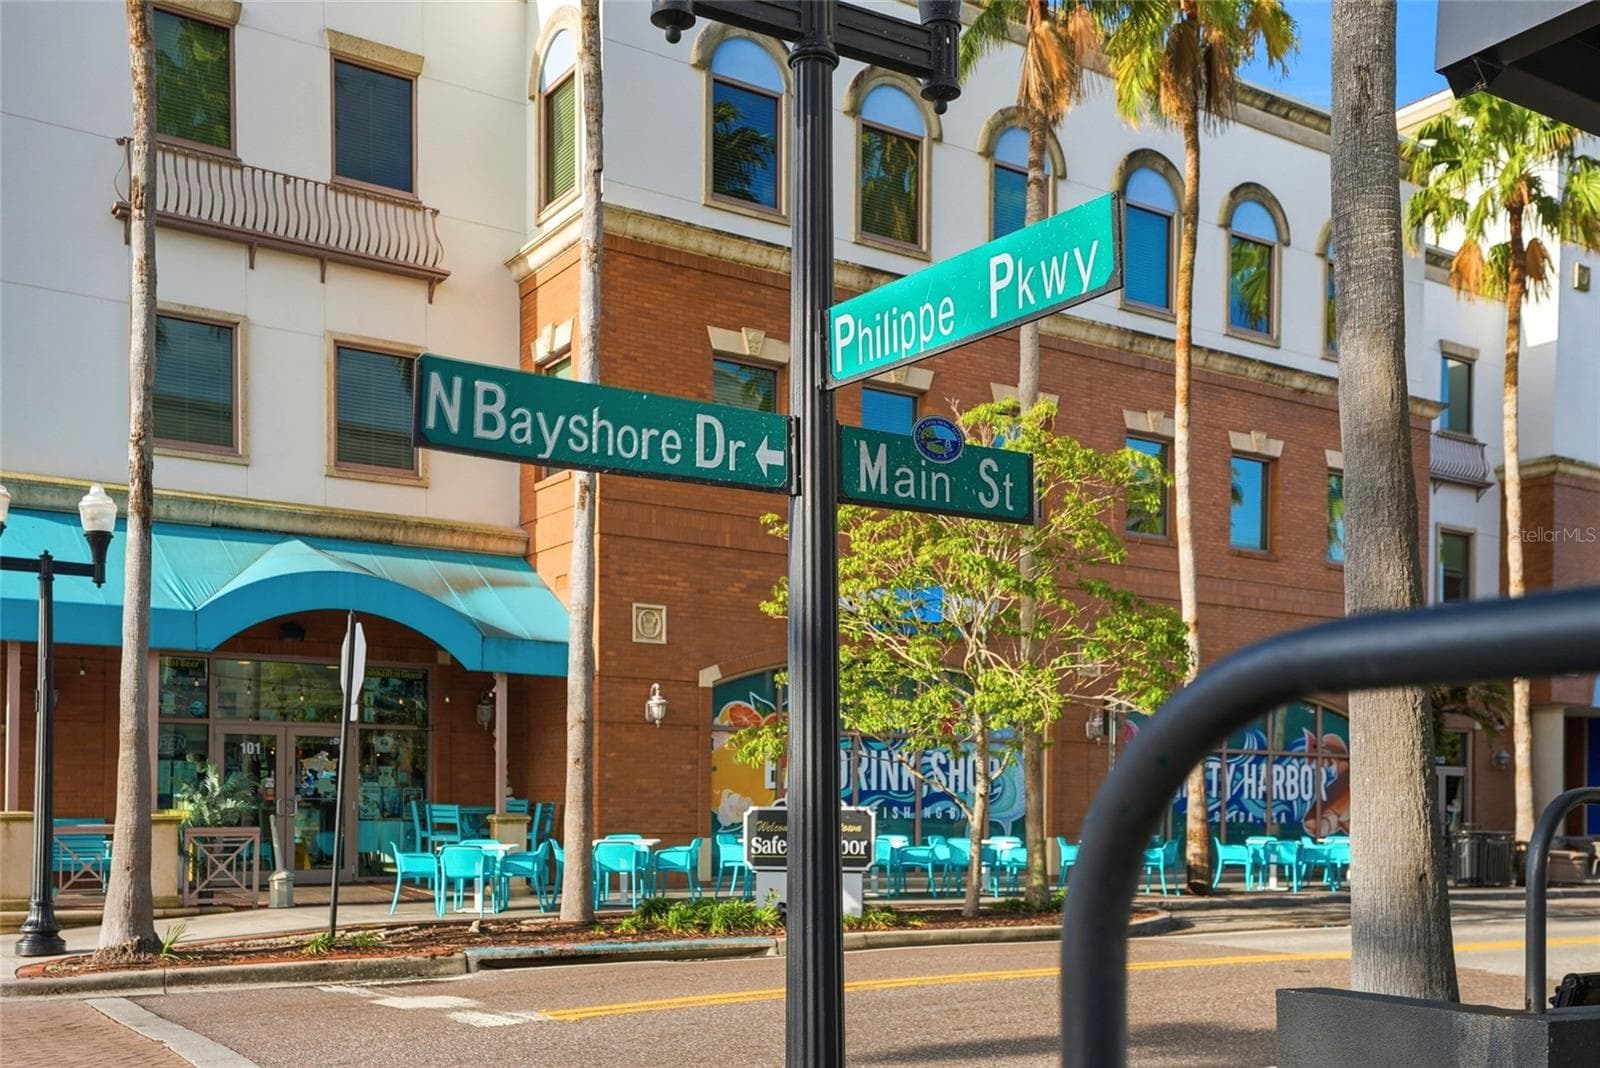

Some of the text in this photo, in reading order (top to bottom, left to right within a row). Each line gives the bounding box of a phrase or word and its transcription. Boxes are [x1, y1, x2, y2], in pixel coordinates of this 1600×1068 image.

[834, 239, 1099, 373] Philippe Pkwy
[425, 371, 746, 472] N Bayshore Dr
[858, 439, 1015, 512] Main St
[240, 742, 261, 755] 101
[751, 835, 788, 855] Safe
